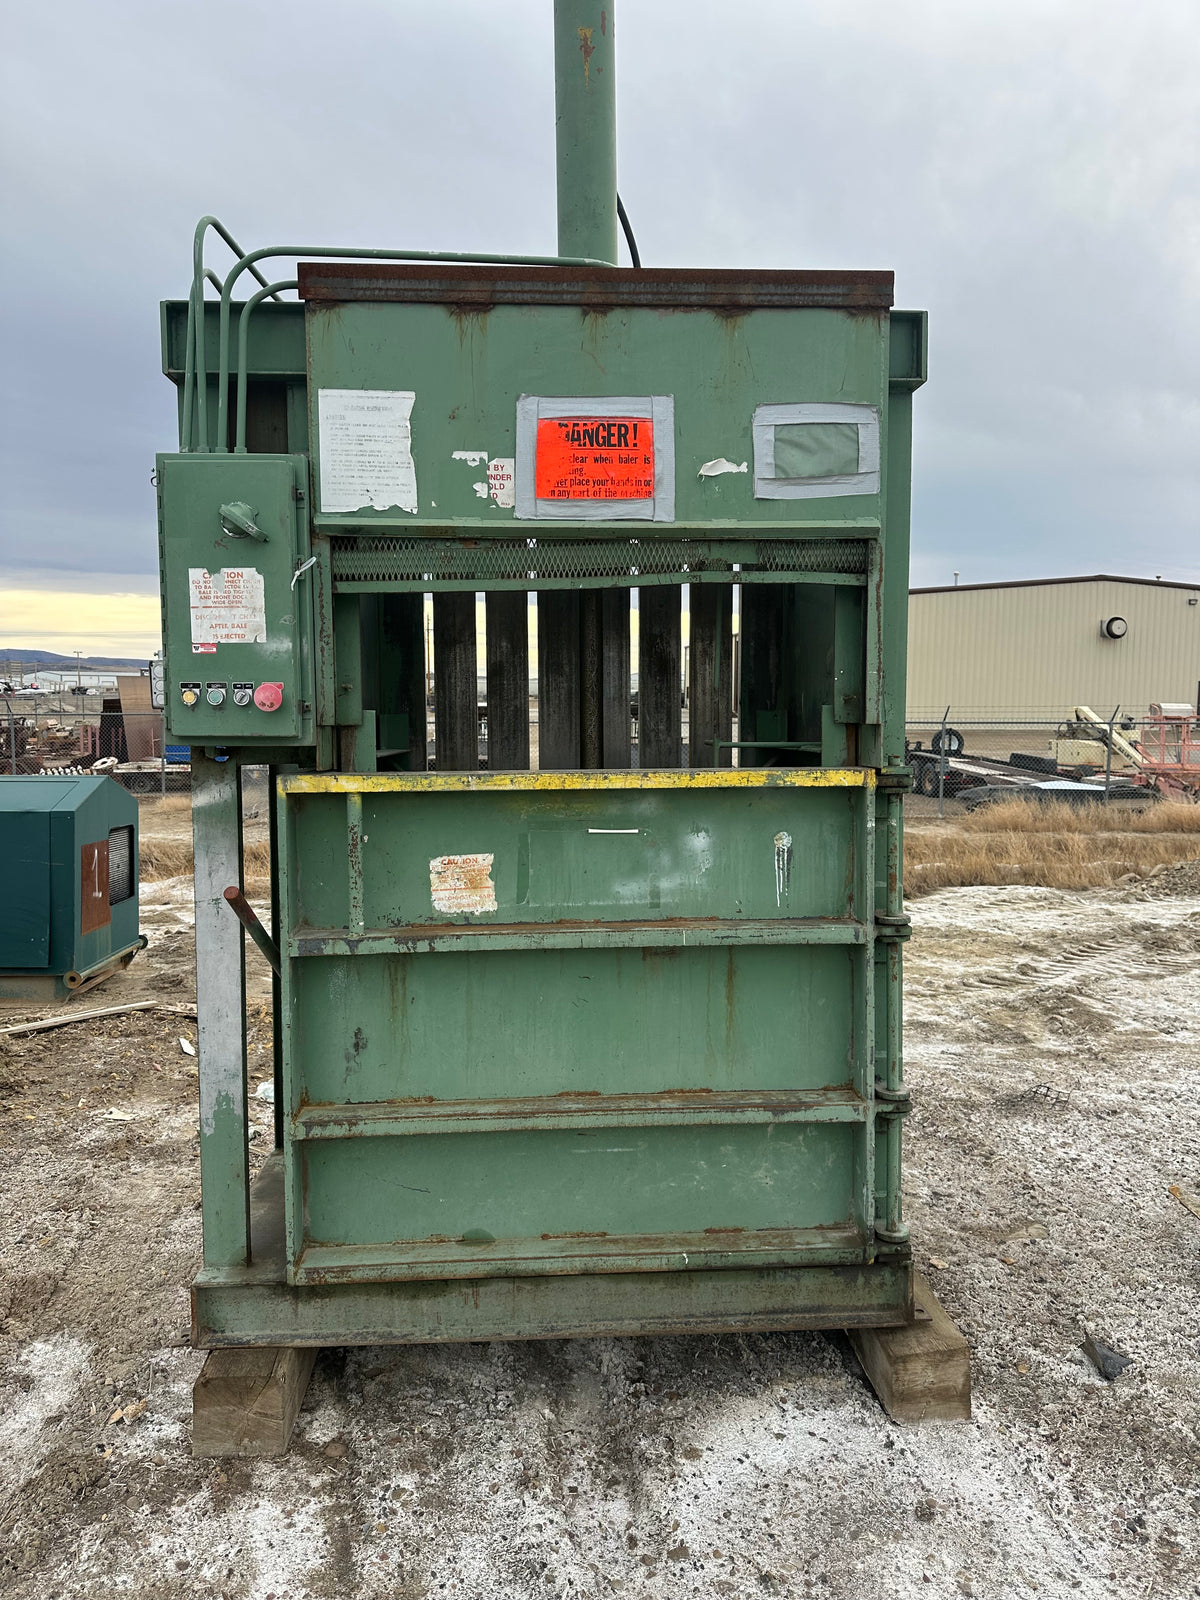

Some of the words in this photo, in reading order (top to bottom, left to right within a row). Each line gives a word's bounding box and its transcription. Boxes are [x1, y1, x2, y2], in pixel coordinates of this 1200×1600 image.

[619, 454, 639, 464] baler
[644, 454, 651, 464] is
[493, 464, 505, 472] BY
[569, 476, 590, 488] place
[592, 477, 609, 489] your
[635, 477, 642, 487] in
[643, 478, 652, 487] or
[557, 488, 571, 499] any
[441, 857, 478, 865] CAUION
